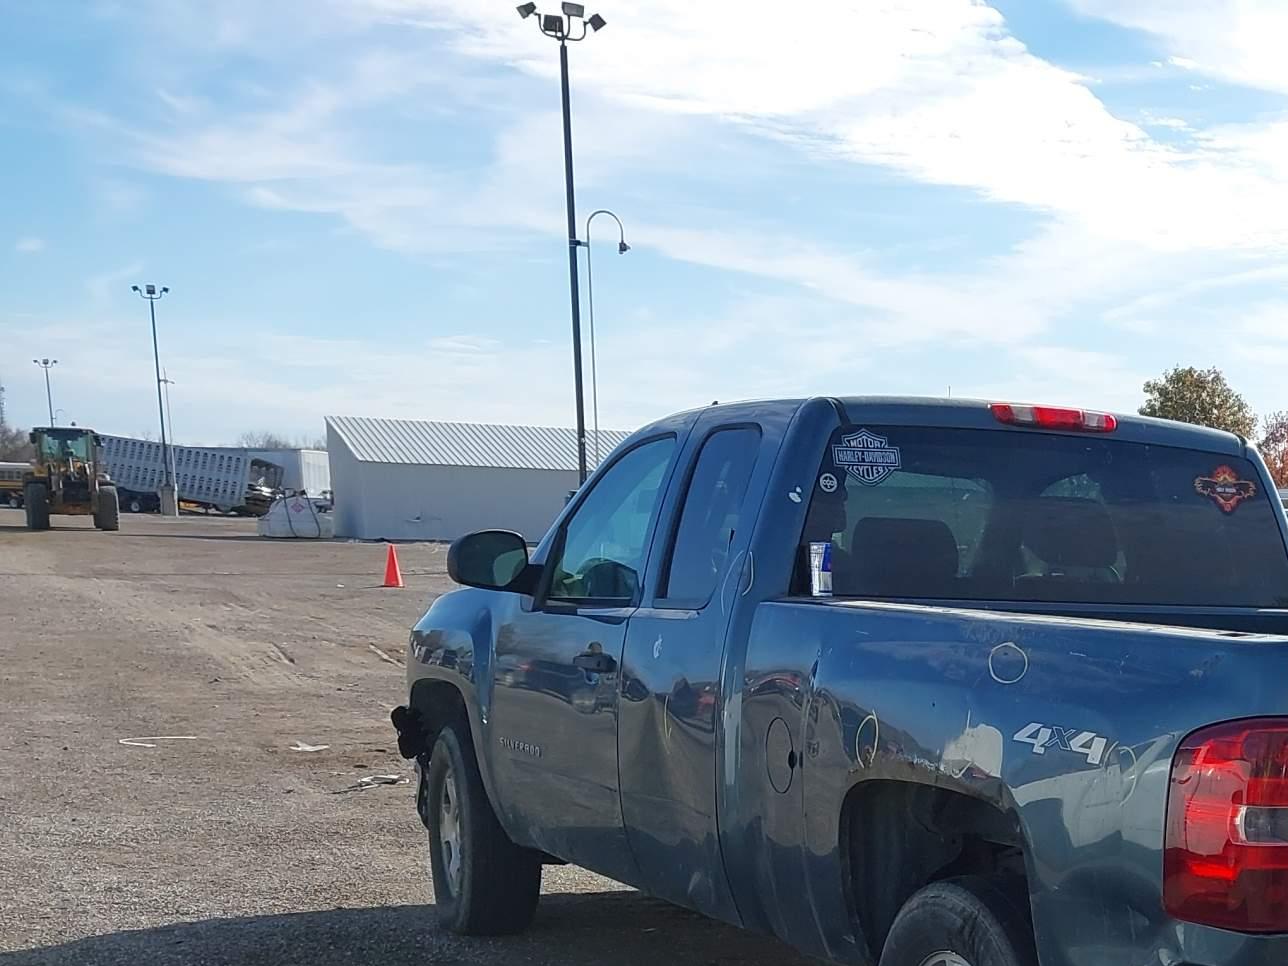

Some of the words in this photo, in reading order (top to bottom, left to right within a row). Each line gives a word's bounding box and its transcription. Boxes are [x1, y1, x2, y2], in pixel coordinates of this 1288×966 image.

[849, 435, 881, 449] MOTOR
[838, 450, 896, 463] HARLEY-DAVIDSON
[853, 465, 884, 480] CYCLES
[499, 736, 541, 758] SILVERADO
